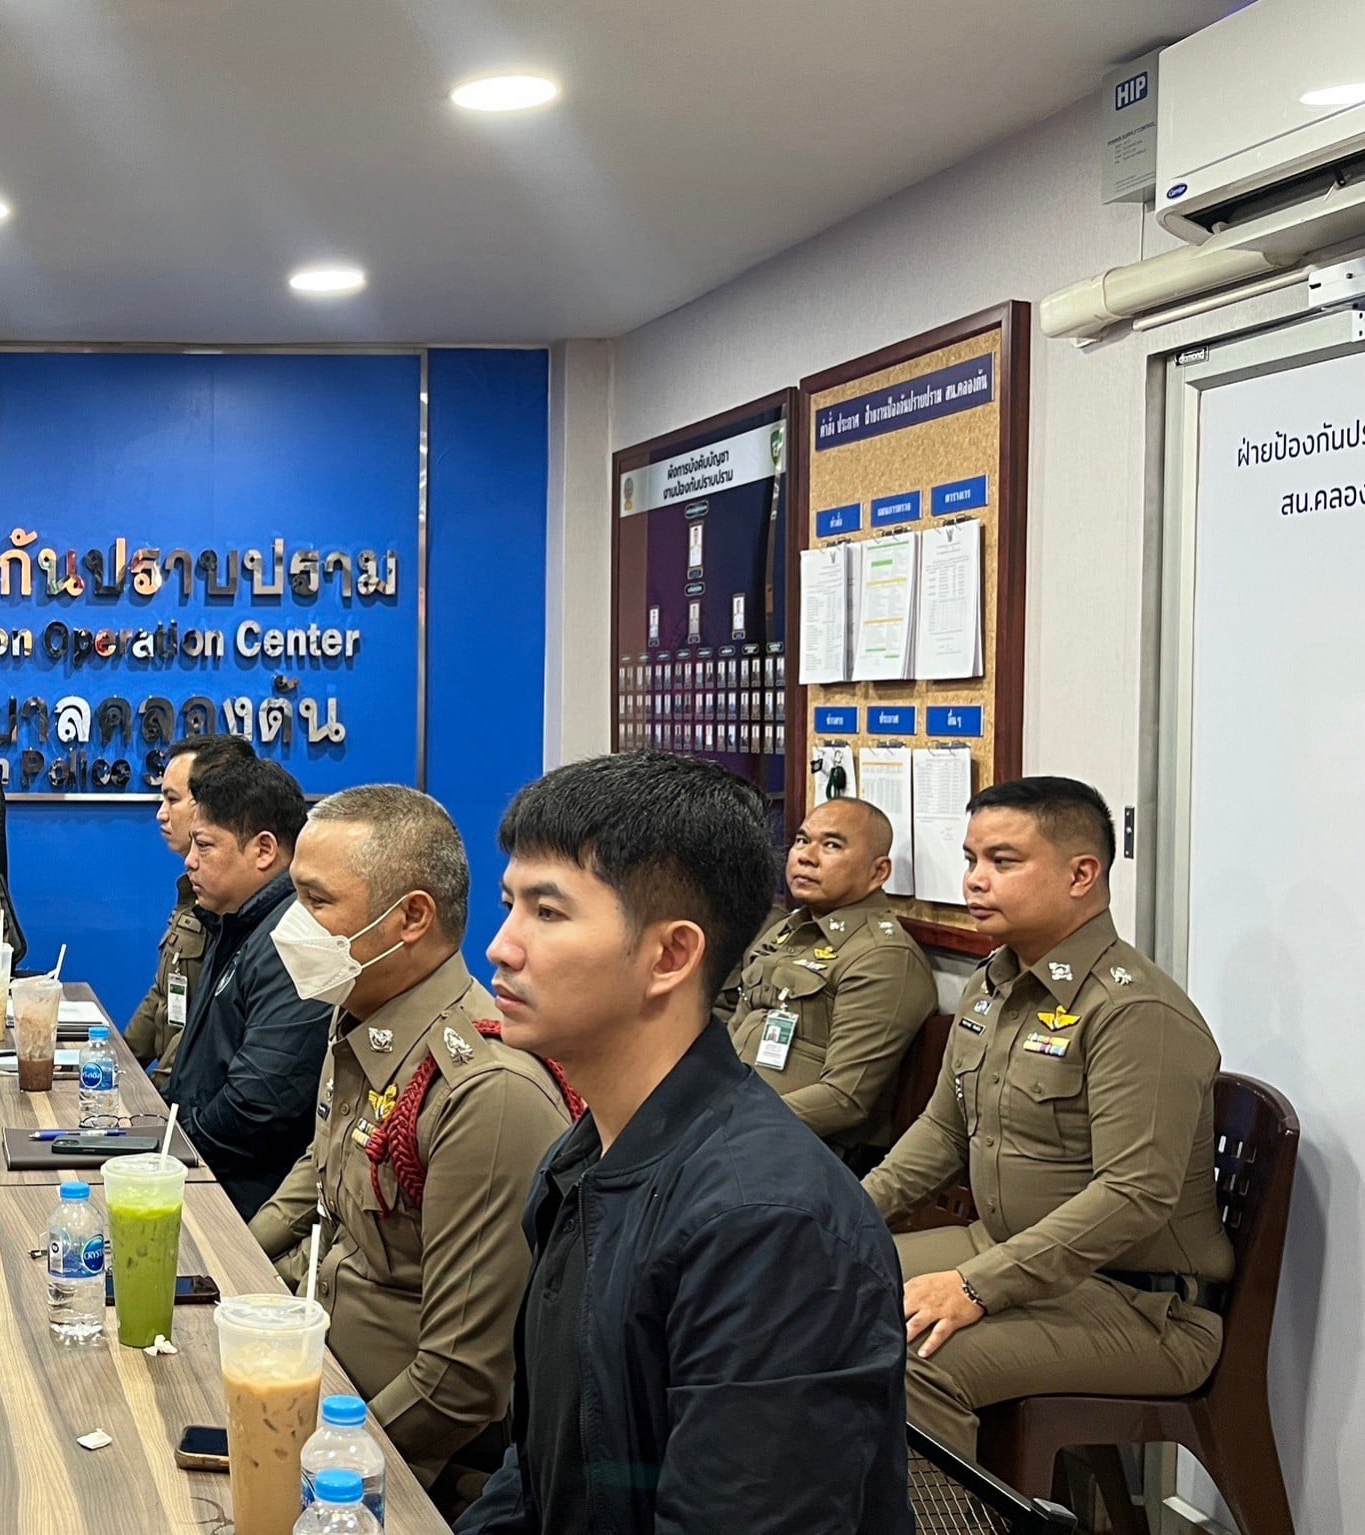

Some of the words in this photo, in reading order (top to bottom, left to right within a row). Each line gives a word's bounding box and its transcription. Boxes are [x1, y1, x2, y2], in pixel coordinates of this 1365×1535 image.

[1116, 75, 1147, 109] HIP
[43, 619, 224, 666] Operation
[235, 619, 361, 657] Center
[21, 749, 132, 787] Police
